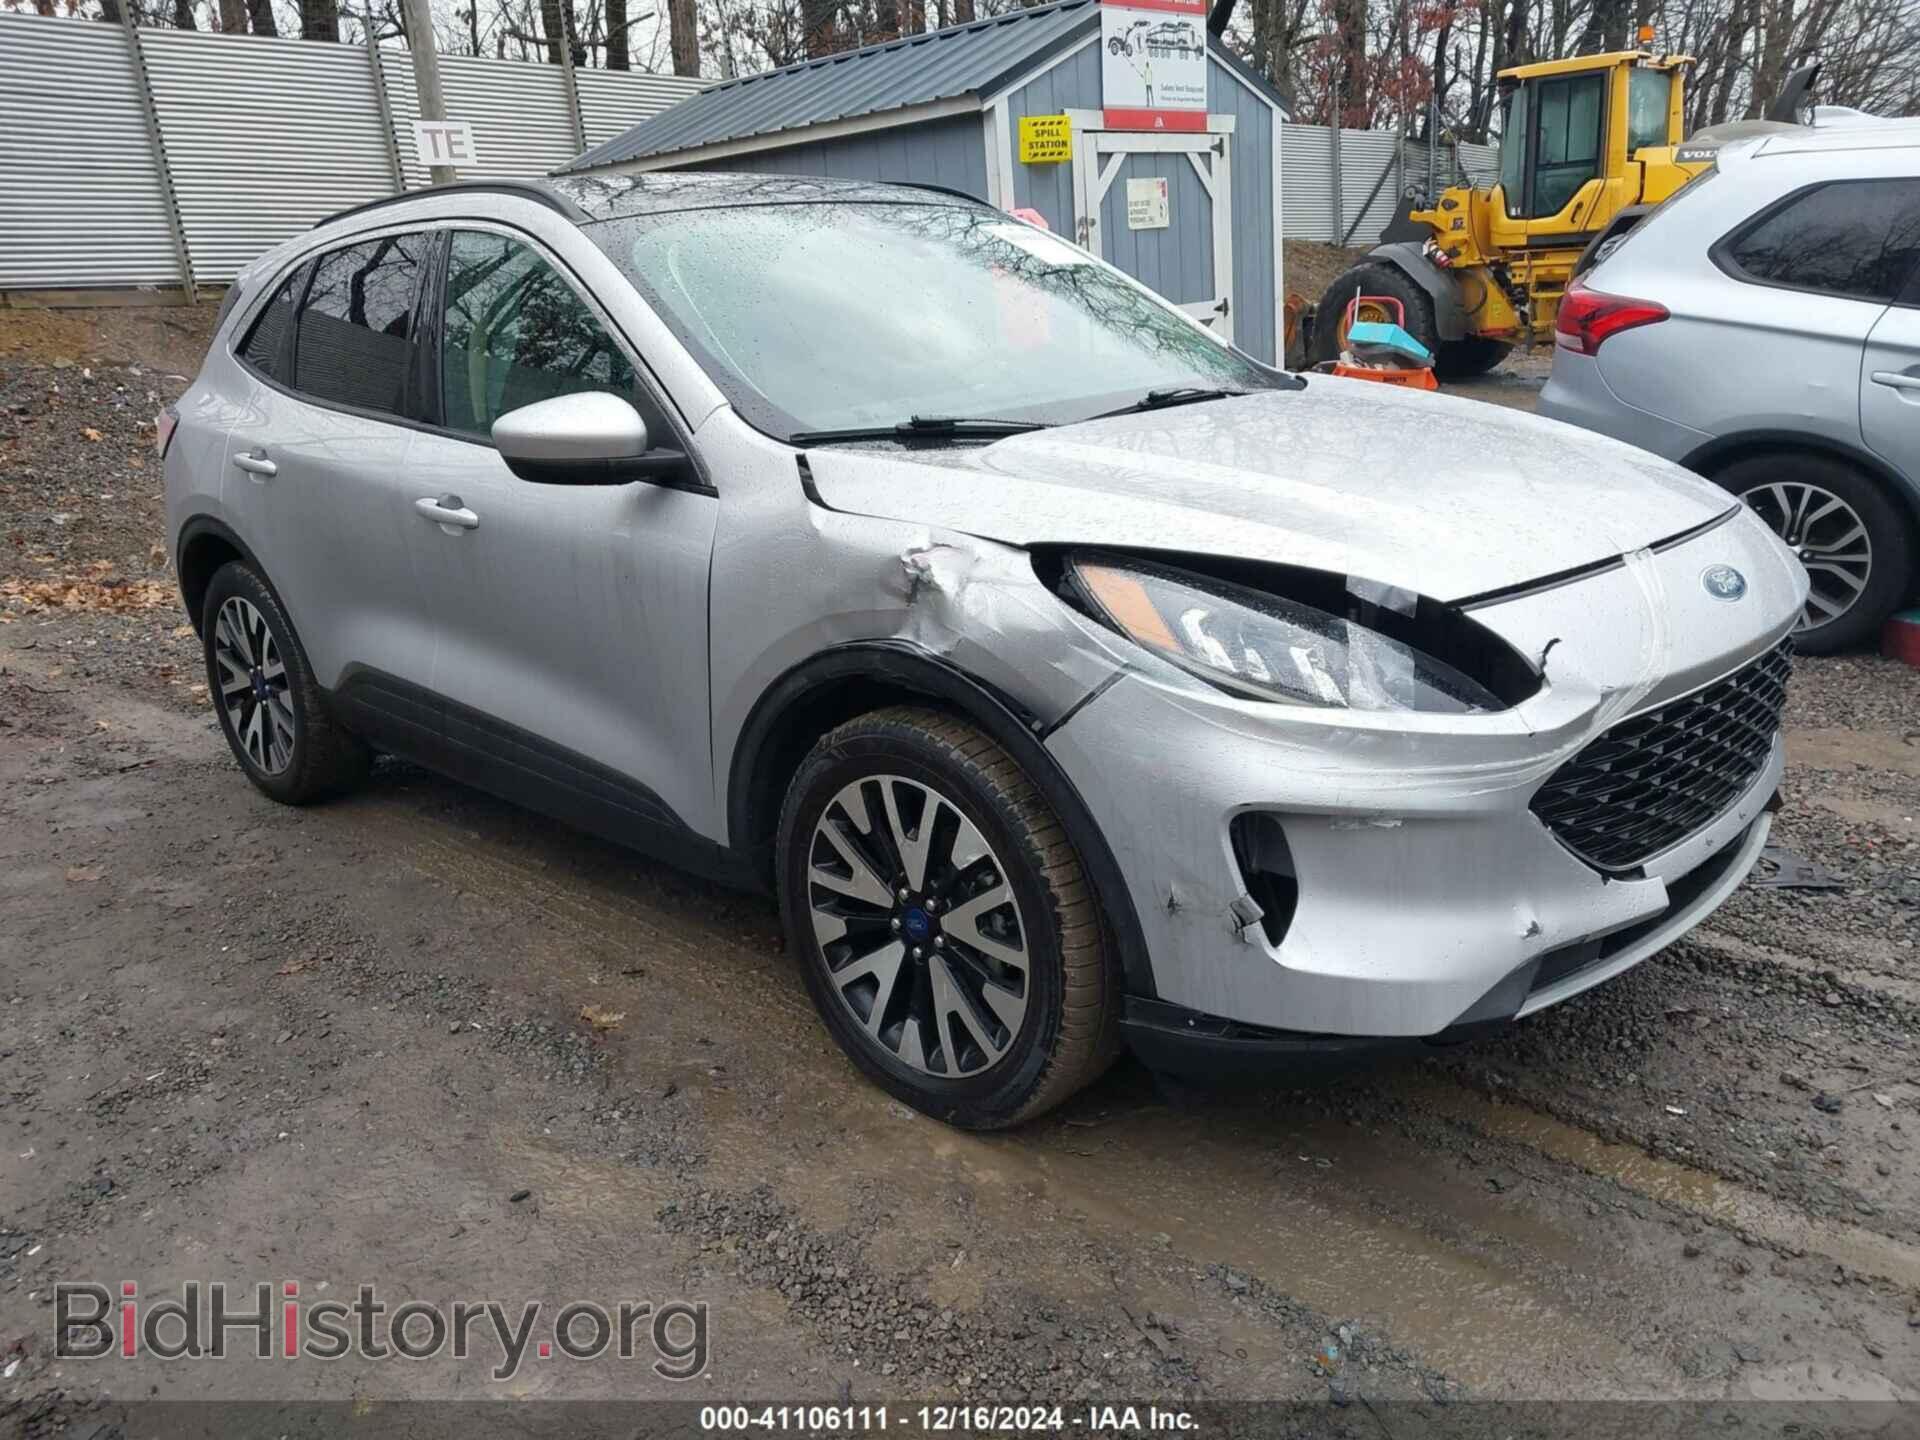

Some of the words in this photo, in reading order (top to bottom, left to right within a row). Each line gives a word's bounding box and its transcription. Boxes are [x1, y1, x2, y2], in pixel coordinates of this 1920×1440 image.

[1034, 128, 1062, 138] SPILL
[422, 128, 468, 159] TE
[1028, 139, 1068, 150] STATION
